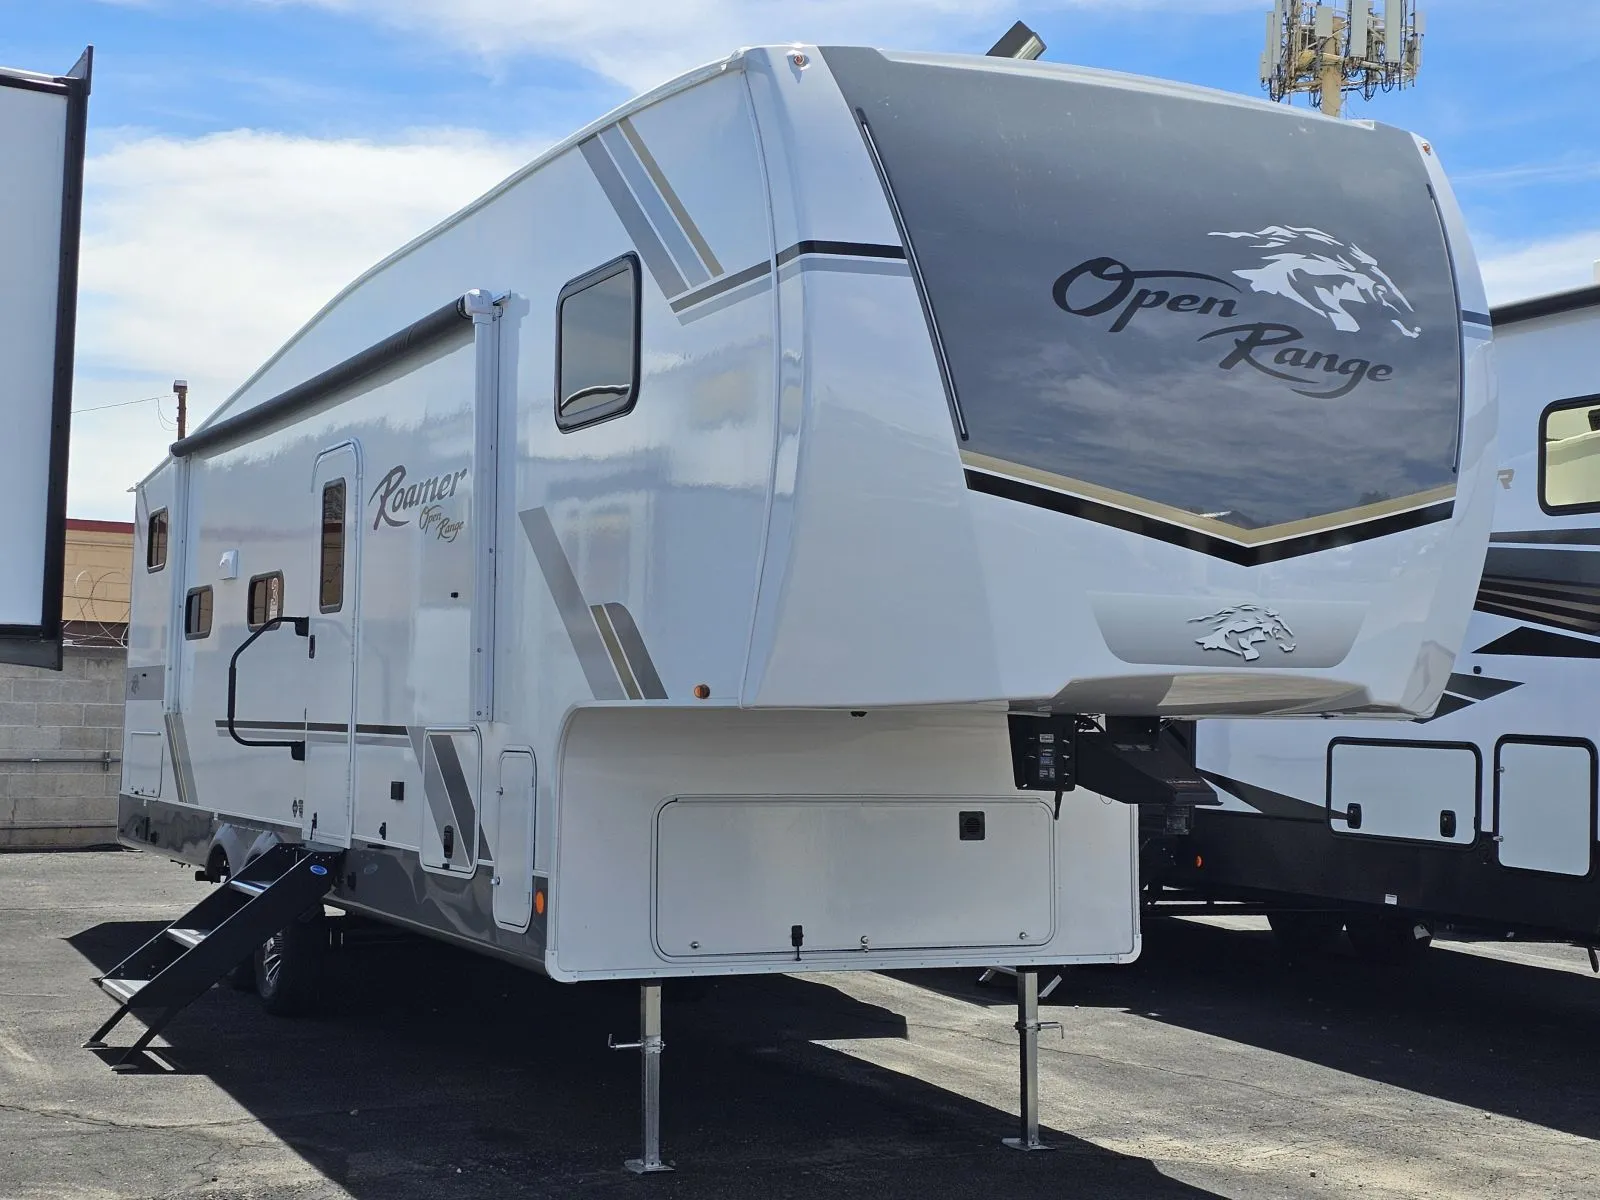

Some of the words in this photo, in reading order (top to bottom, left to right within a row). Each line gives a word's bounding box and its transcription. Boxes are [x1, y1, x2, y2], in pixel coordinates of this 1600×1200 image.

[1052, 256, 1242, 333] Open
[1197, 322, 1393, 399] Range
[368, 465, 467, 530] Roamer
[419, 504, 444, 534] Open
[436, 517, 464, 543] Range
